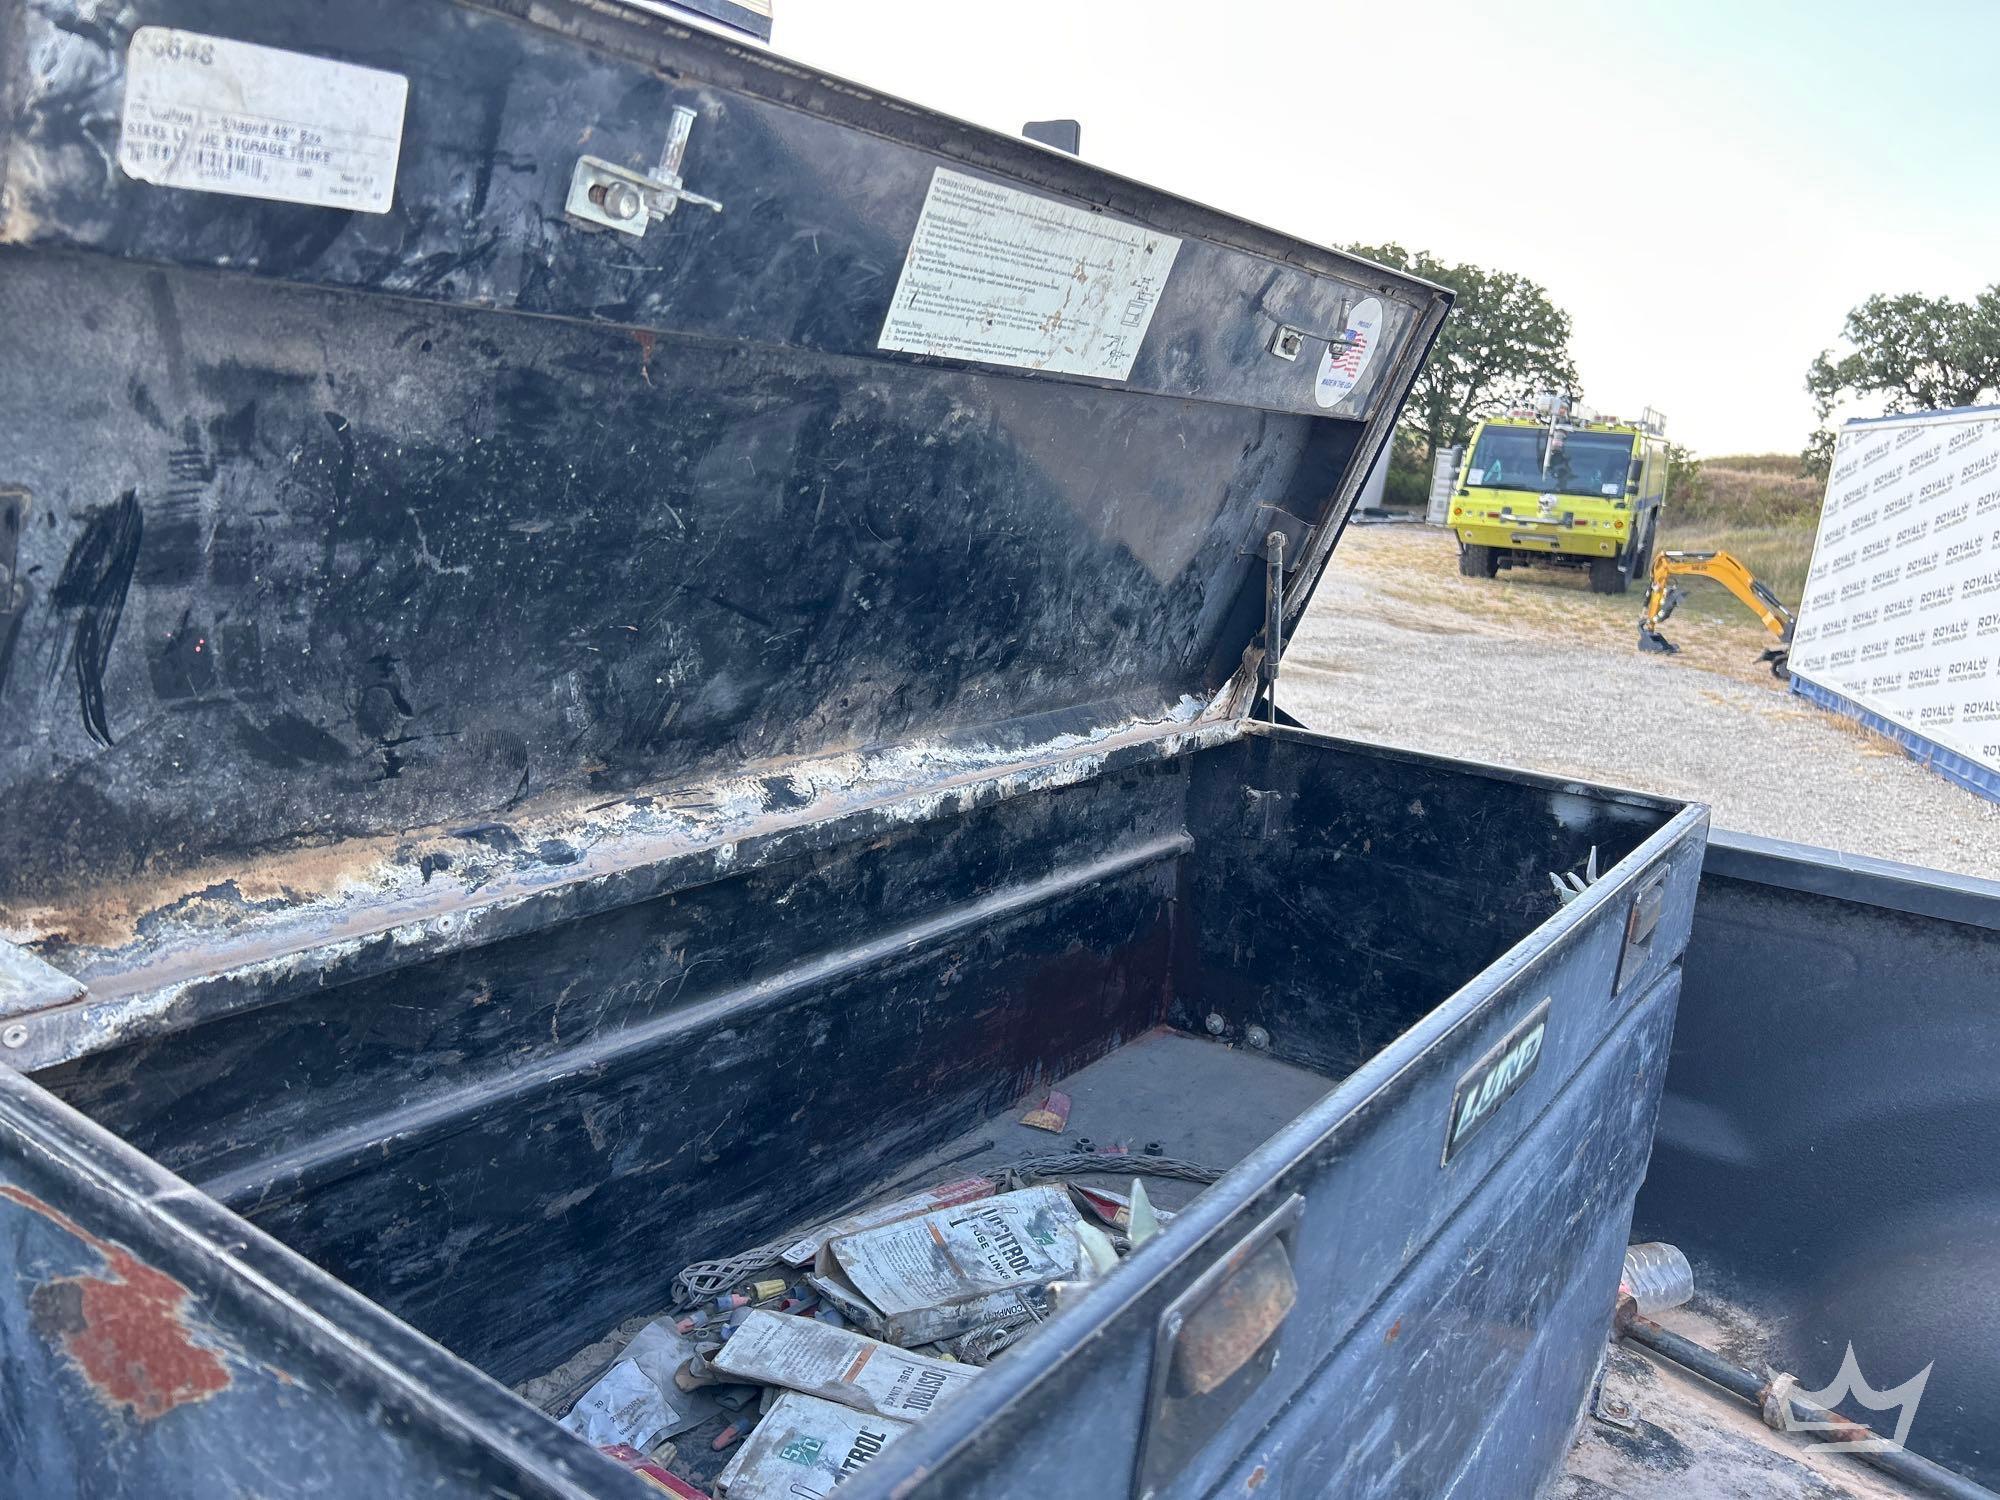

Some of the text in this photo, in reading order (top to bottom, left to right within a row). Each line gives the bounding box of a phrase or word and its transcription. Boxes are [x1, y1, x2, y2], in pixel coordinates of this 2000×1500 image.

[1949, 427, 1976, 448] ROYAL
[1909, 448, 1933, 468] ROYAL
[1962, 456, 1990, 477] ROYAL
[1920, 477, 1946, 497] ROYAL
[1885, 496, 1906, 513] ROYAL
[1851, 513, 1871, 528] ROYAL
[1935, 507, 1960, 525] ROYAL
[1897, 524, 1920, 541] ROYAL
[1863, 540, 1883, 554] ROYAL
[1946, 539, 1974, 558] ROYAL
[1907, 555, 1930, 571] ROYAL
[1872, 568, 1893, 584] ROYAL
[1963, 573, 1993, 591] ROYAL
[1920, 588, 1946, 603] ROYAL
[1884, 600, 1906, 614] ROYAL
[1852, 611, 1872, 624] ROYAL
[1933, 622, 1959, 638] ROYAL
[1895, 633, 1918, 647] ROYAL
[1831, 649, 1850, 661] ROYAL
[1862, 642, 1881, 654] ROYAL
[1908, 667, 1933, 681] ROYAL
[1949, 660, 1978, 674] ROYAL
[1873, 674, 1894, 687] ROYAL
[1921, 707, 1946, 718] ROYAL
[1963, 701, 1993, 714] ROYAL
[969, 1223, 1011, 1280] FUSE LINKS
[897, 1365, 915, 1384] FUSE
[594, 1400, 604, 1409] 20
